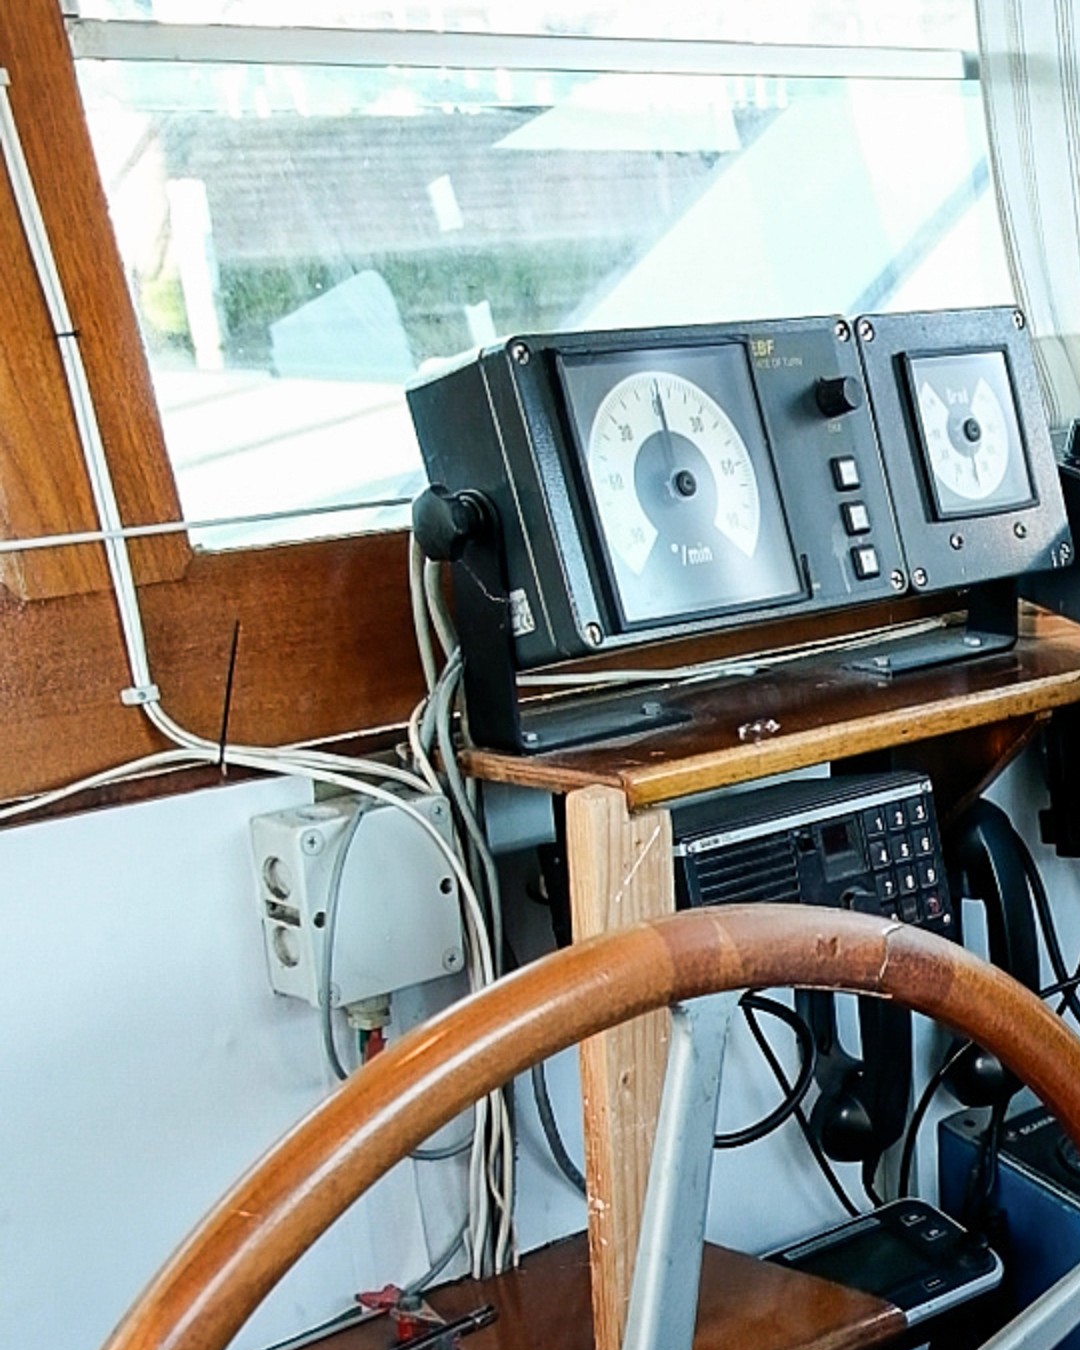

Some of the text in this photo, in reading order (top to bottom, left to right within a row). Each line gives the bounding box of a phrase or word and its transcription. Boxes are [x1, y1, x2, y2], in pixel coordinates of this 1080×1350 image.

[875, 804, 925, 831] 1 2 3
[901, 842, 909, 857] 5
[884, 880, 893, 896] 7
[927, 868, 935, 883] 9
